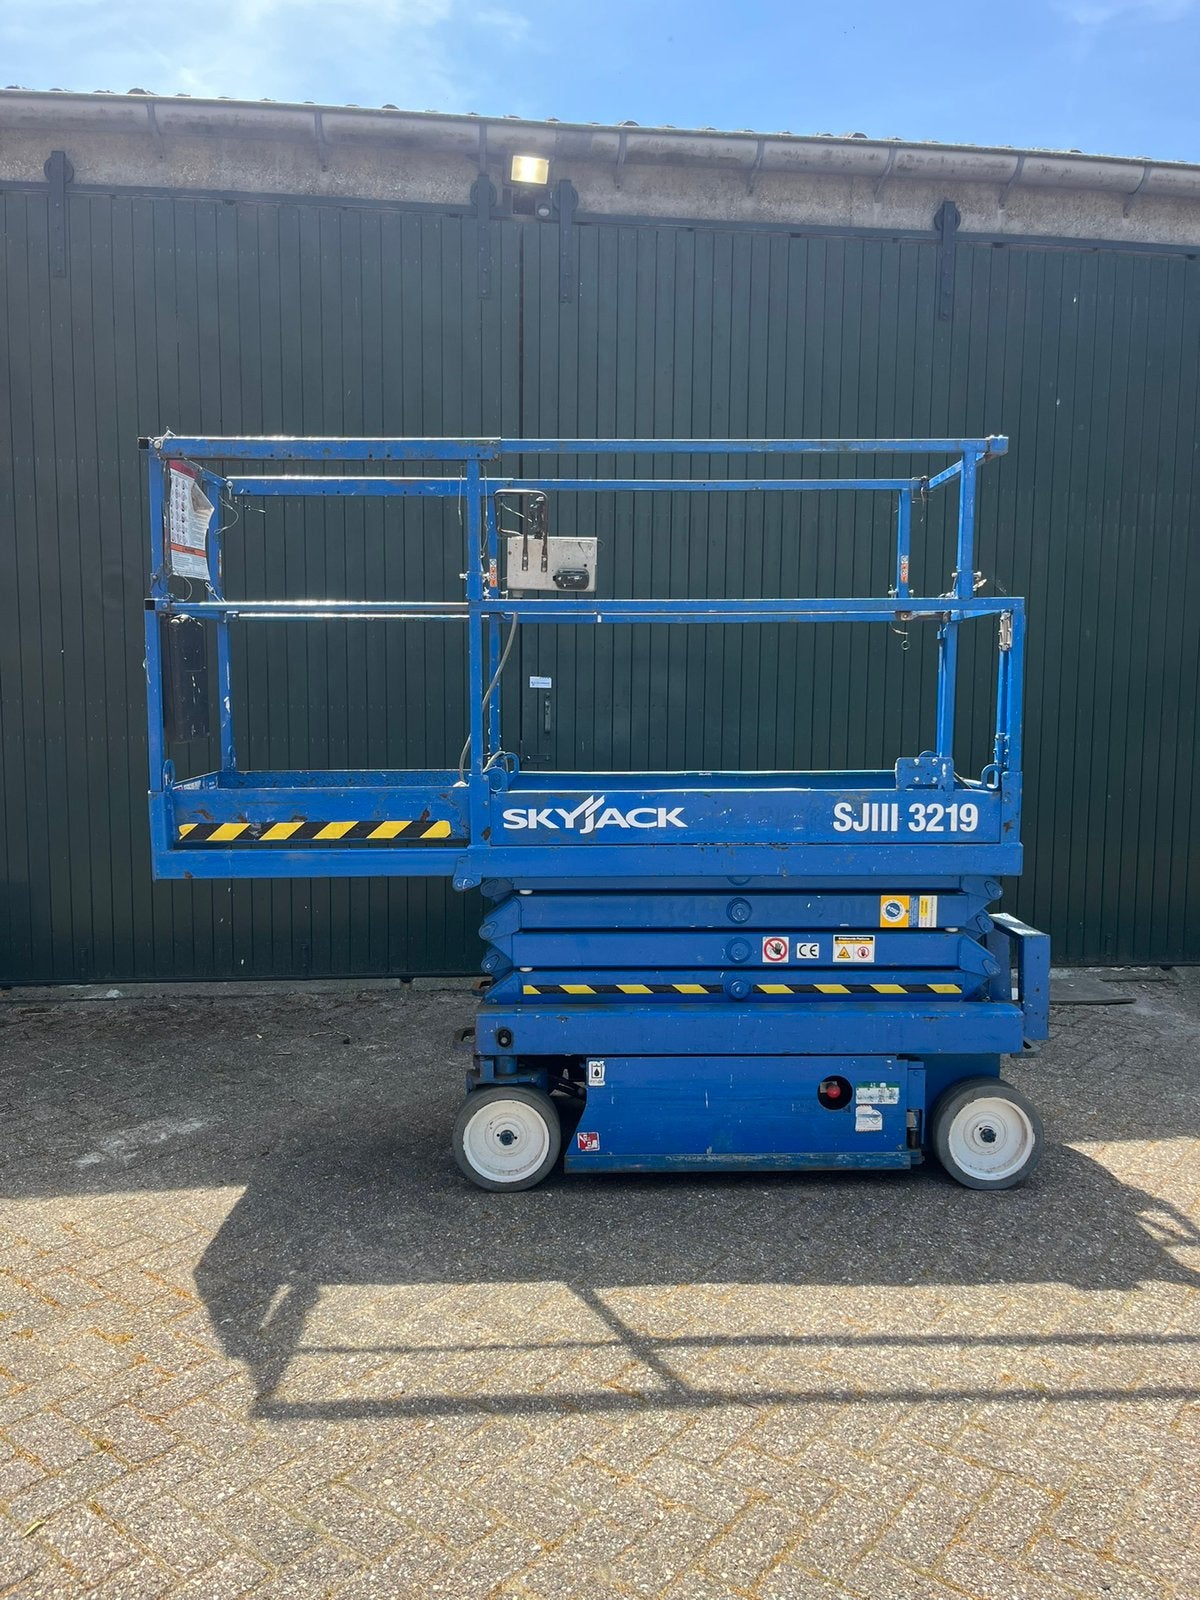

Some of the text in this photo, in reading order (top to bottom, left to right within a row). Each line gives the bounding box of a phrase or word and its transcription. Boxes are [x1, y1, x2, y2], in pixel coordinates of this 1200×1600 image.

[502, 795, 688, 834] SKYJACK
[833, 802, 979, 832] SJIII 3219
[799, 944, 818, 957] CE
